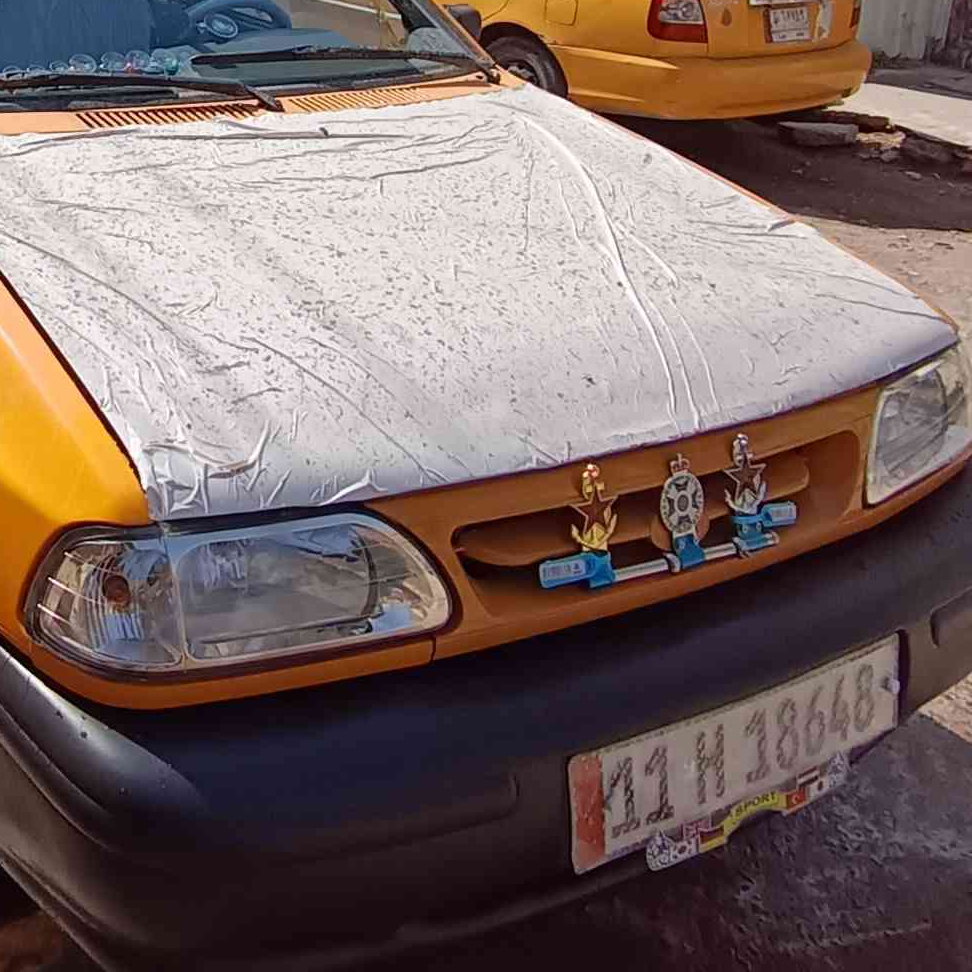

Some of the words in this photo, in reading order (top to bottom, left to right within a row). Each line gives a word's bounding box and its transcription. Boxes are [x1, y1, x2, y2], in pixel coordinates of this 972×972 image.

[609, 745, 675, 839] 11
[744, 662, 876, 784] 18648
[733, 791, 777, 817] SPORT
